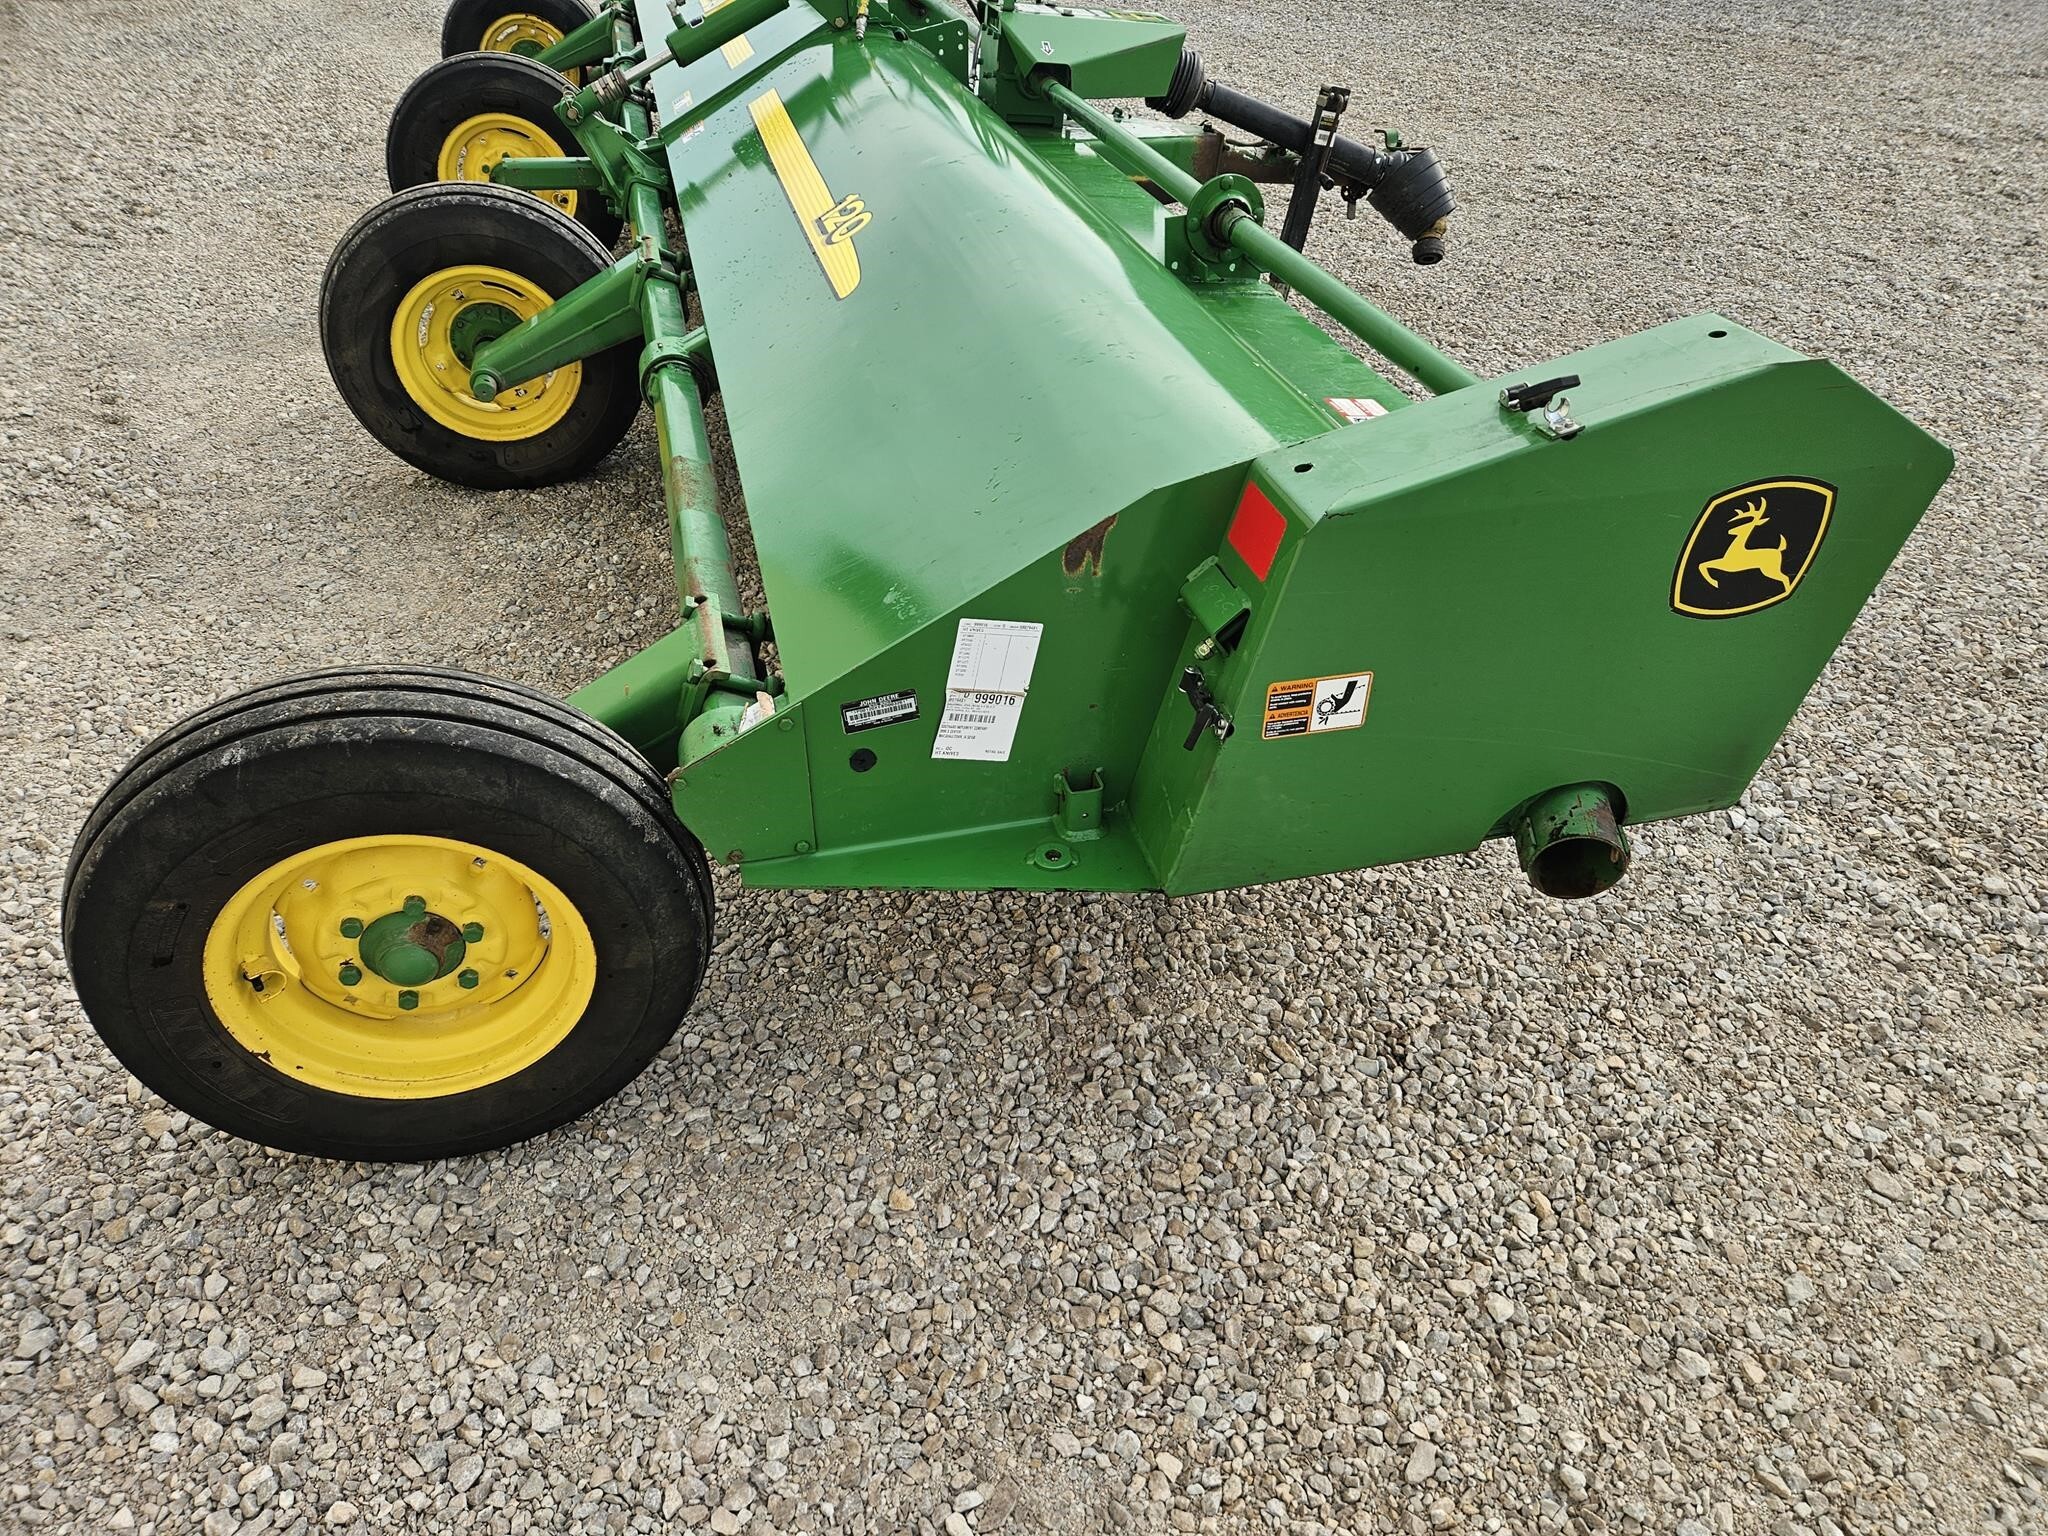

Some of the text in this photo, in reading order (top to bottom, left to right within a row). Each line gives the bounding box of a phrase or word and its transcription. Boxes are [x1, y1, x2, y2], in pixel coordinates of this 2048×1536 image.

[820, 193, 873, 245] 120
[1280, 682, 1313, 691] WARNING
[860, 698, 877, 706] JOHN
[974, 693, 1016, 706] 999016
